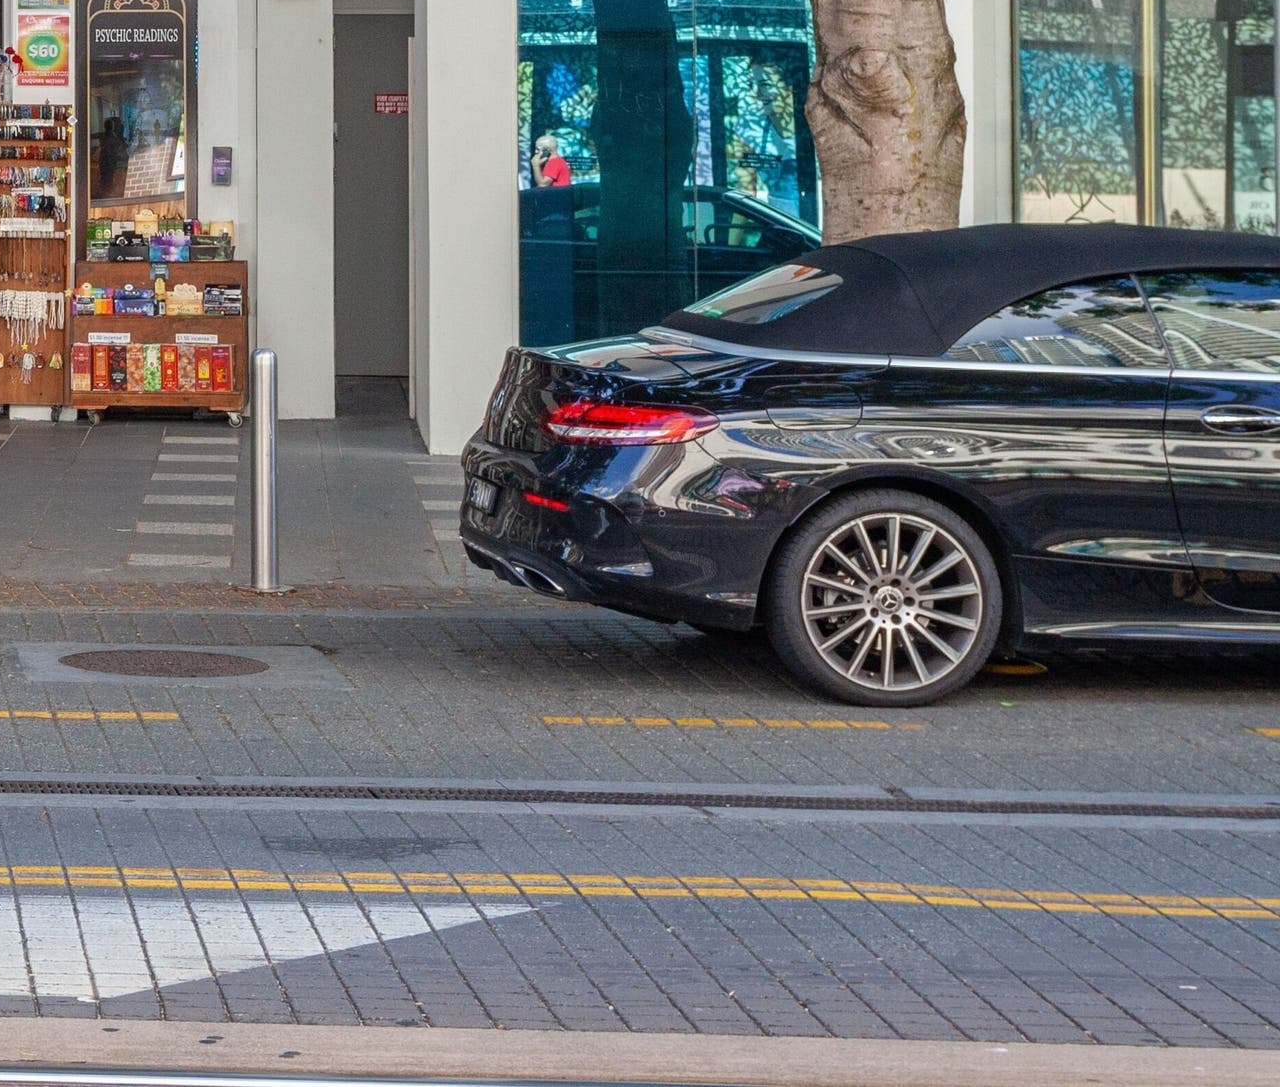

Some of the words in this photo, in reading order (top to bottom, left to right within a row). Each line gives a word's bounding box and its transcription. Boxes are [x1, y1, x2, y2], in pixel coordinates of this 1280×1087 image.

[95, 28, 132, 43] PSYCHIC
[134, 28, 179, 43] READINGS
[28, 44, 59, 59] $60
